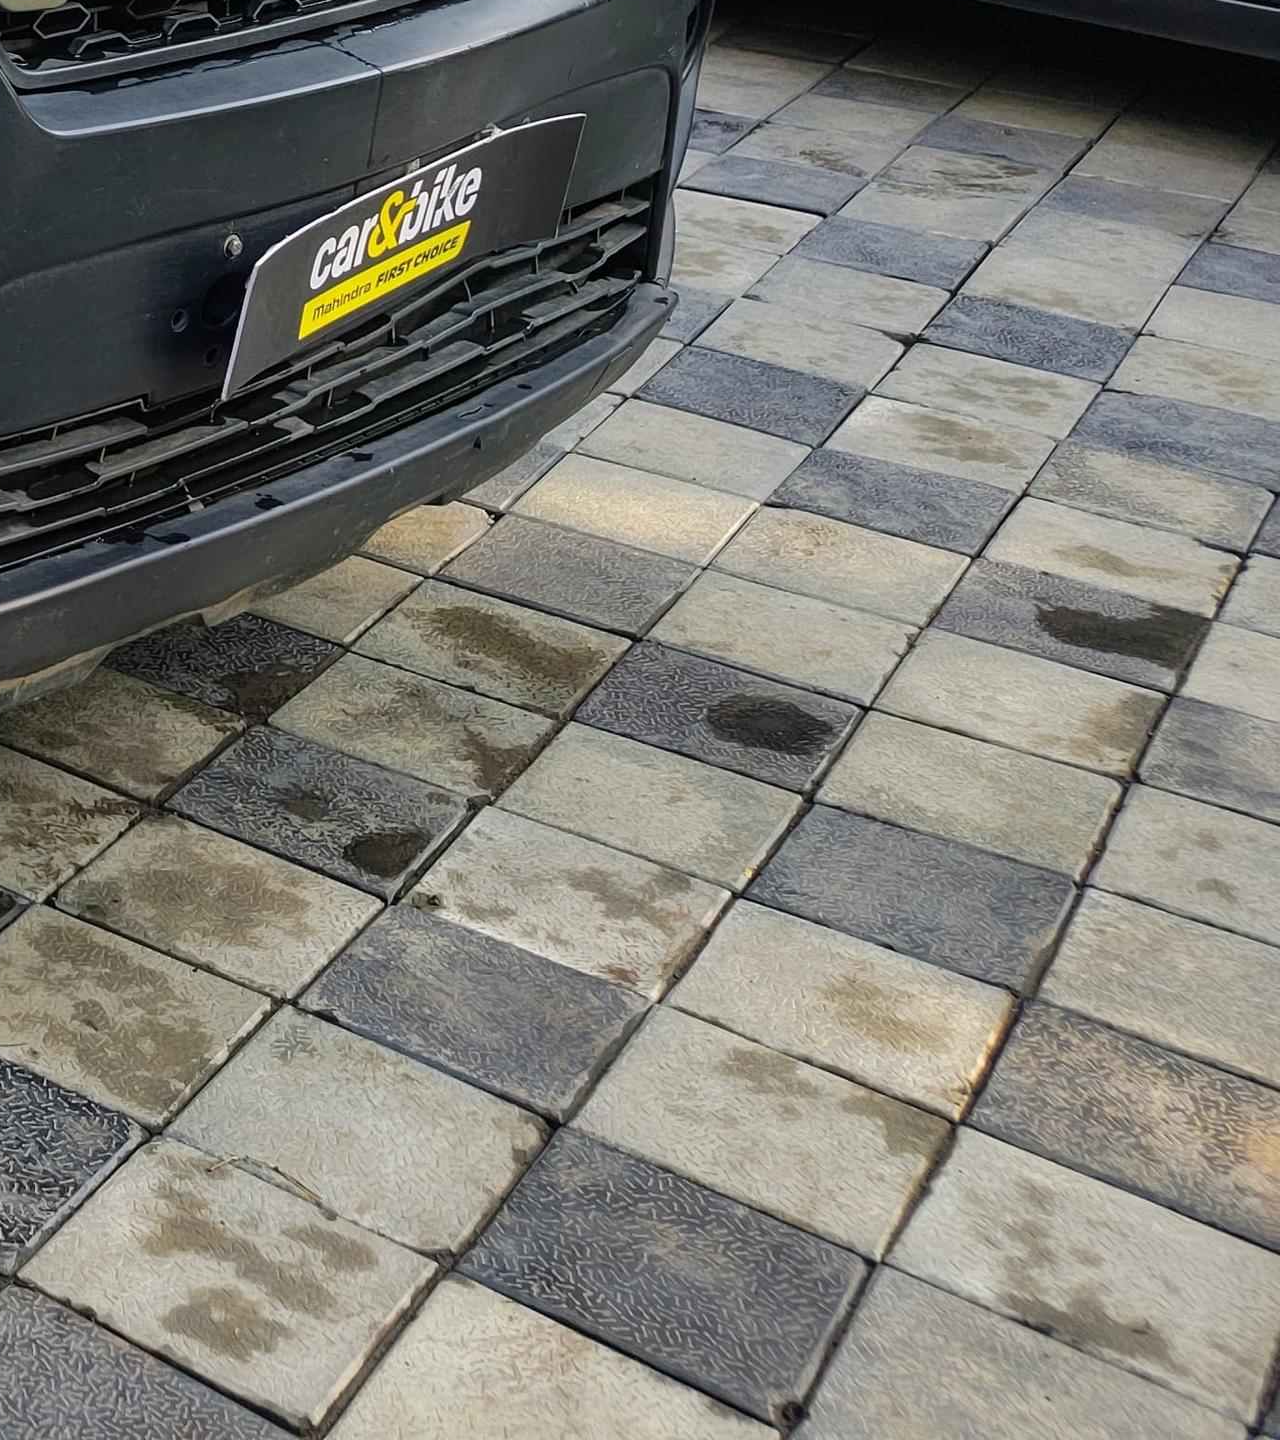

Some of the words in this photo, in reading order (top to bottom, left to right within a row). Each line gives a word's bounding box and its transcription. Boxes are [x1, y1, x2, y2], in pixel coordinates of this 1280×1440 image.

[309, 163, 483, 290] car&bike
[312, 281, 372, 322] Mahindra
[375, 260, 412, 289] FIRST
[413, 235, 461, 269] CHOICE
